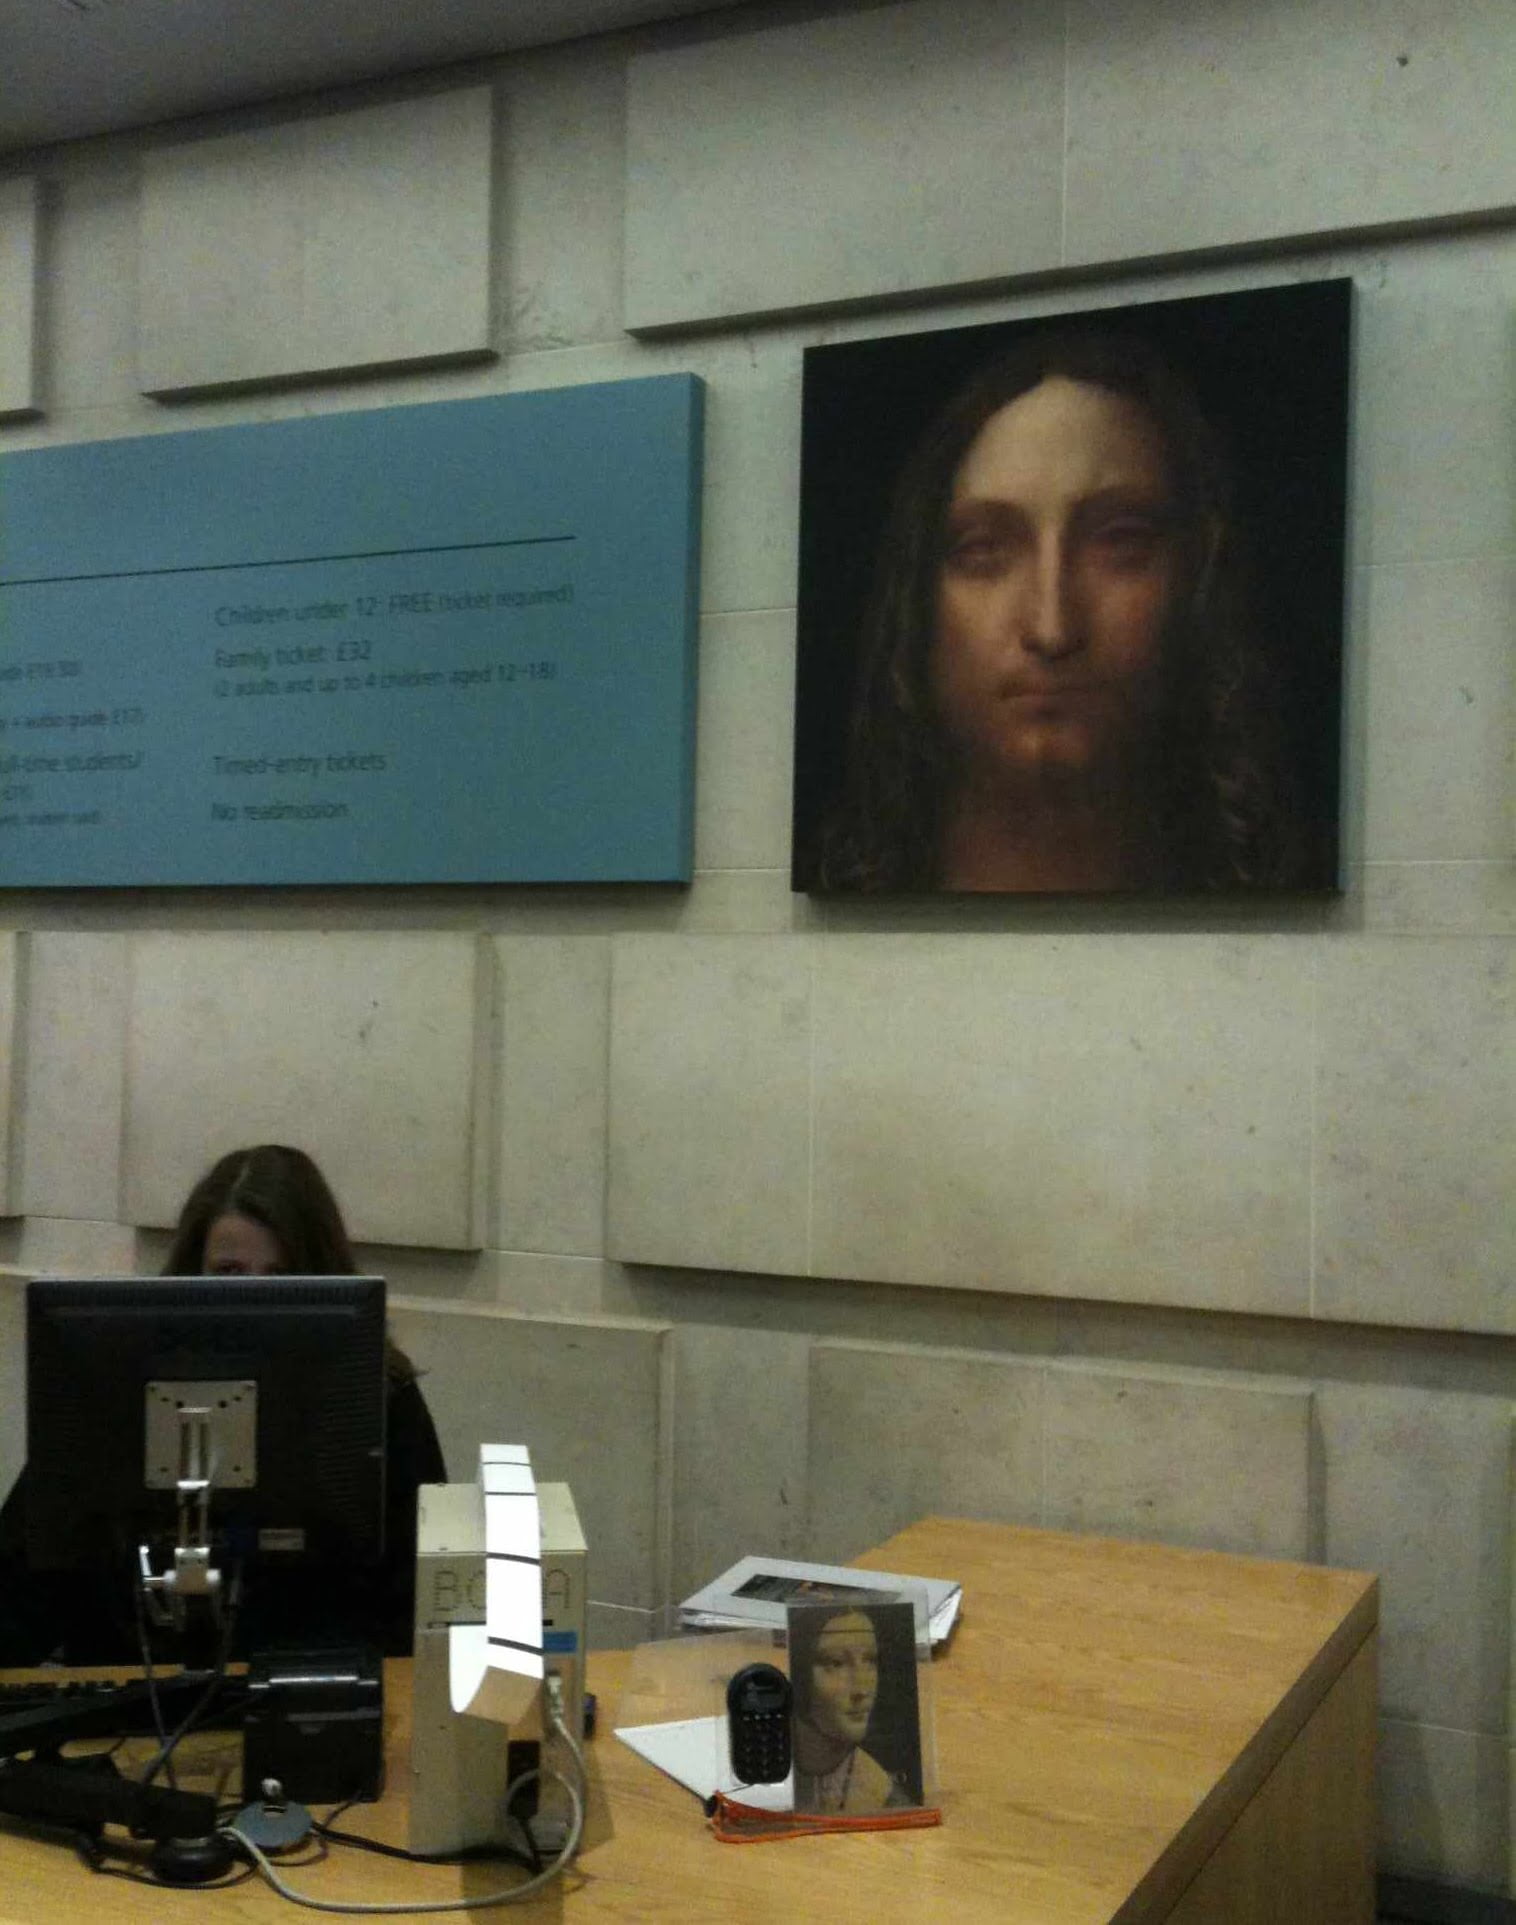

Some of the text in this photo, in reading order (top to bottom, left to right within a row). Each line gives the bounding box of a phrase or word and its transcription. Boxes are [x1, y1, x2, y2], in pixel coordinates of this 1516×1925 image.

[215, 605, 290, 626] Children
[294, 602, 349, 620] under
[388, 592, 432, 613] FREE
[215, 648, 269, 671] Family
[336, 640, 371, 662] £32
[284, 676, 313, 694] and
[364, 671, 376, 686] 4
[449, 668, 491, 689] aged
[326, 753, 387, 772] tickets
[212, 803, 238, 821] No
